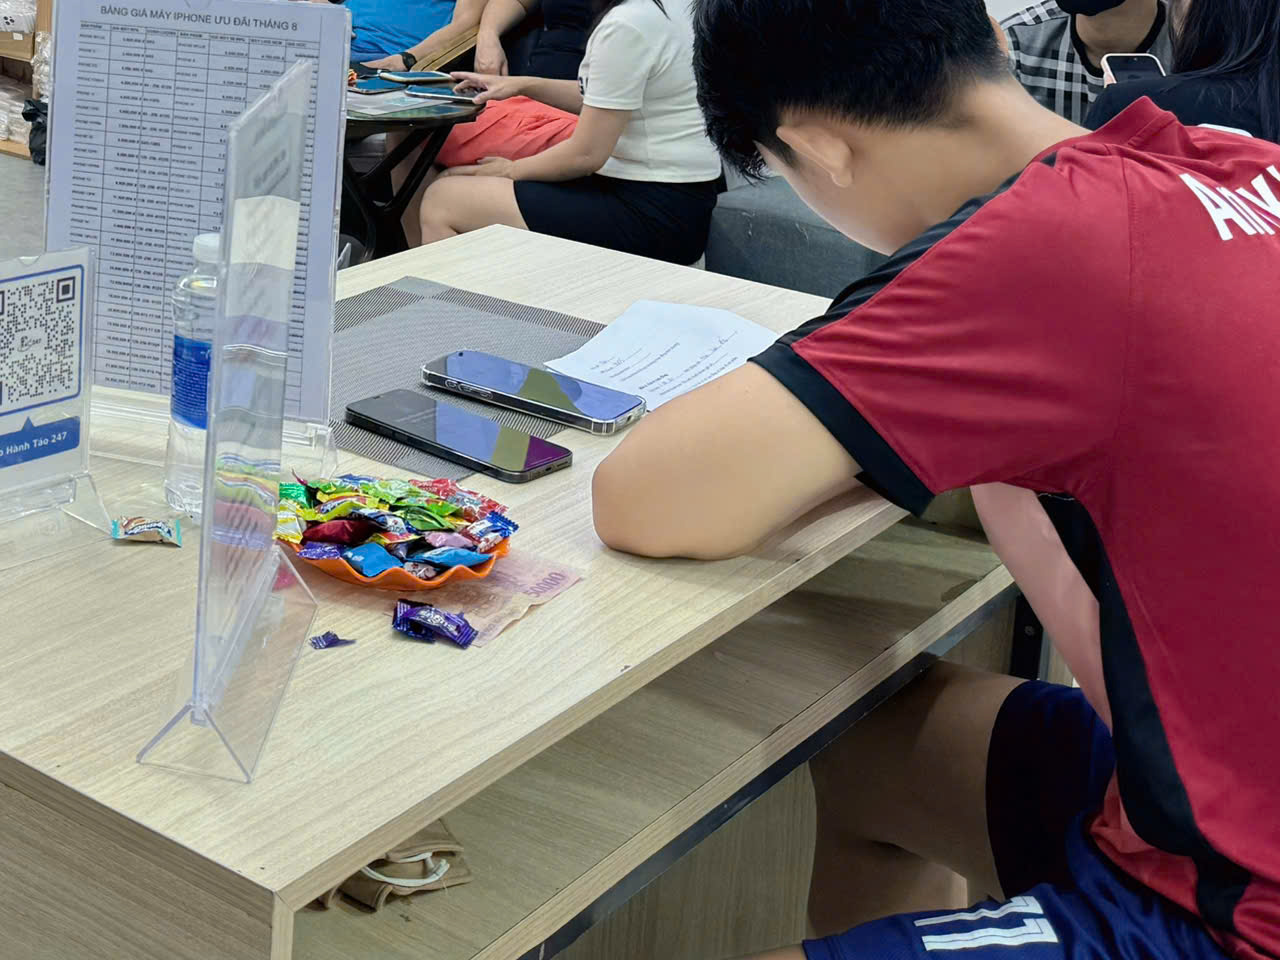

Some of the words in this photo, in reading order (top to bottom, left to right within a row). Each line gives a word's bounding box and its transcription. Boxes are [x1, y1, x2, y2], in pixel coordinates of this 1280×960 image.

[130, 7, 148, 19] GIÁ
[149, 8, 172, 21] MÁY
[173, 12, 212, 25] IPHONE
[252, 16, 289, 31] THÁNG
[291, 22, 298, 32] 8
[6, 441, 30, 455] Hành
[50, 431, 68, 443] 247
